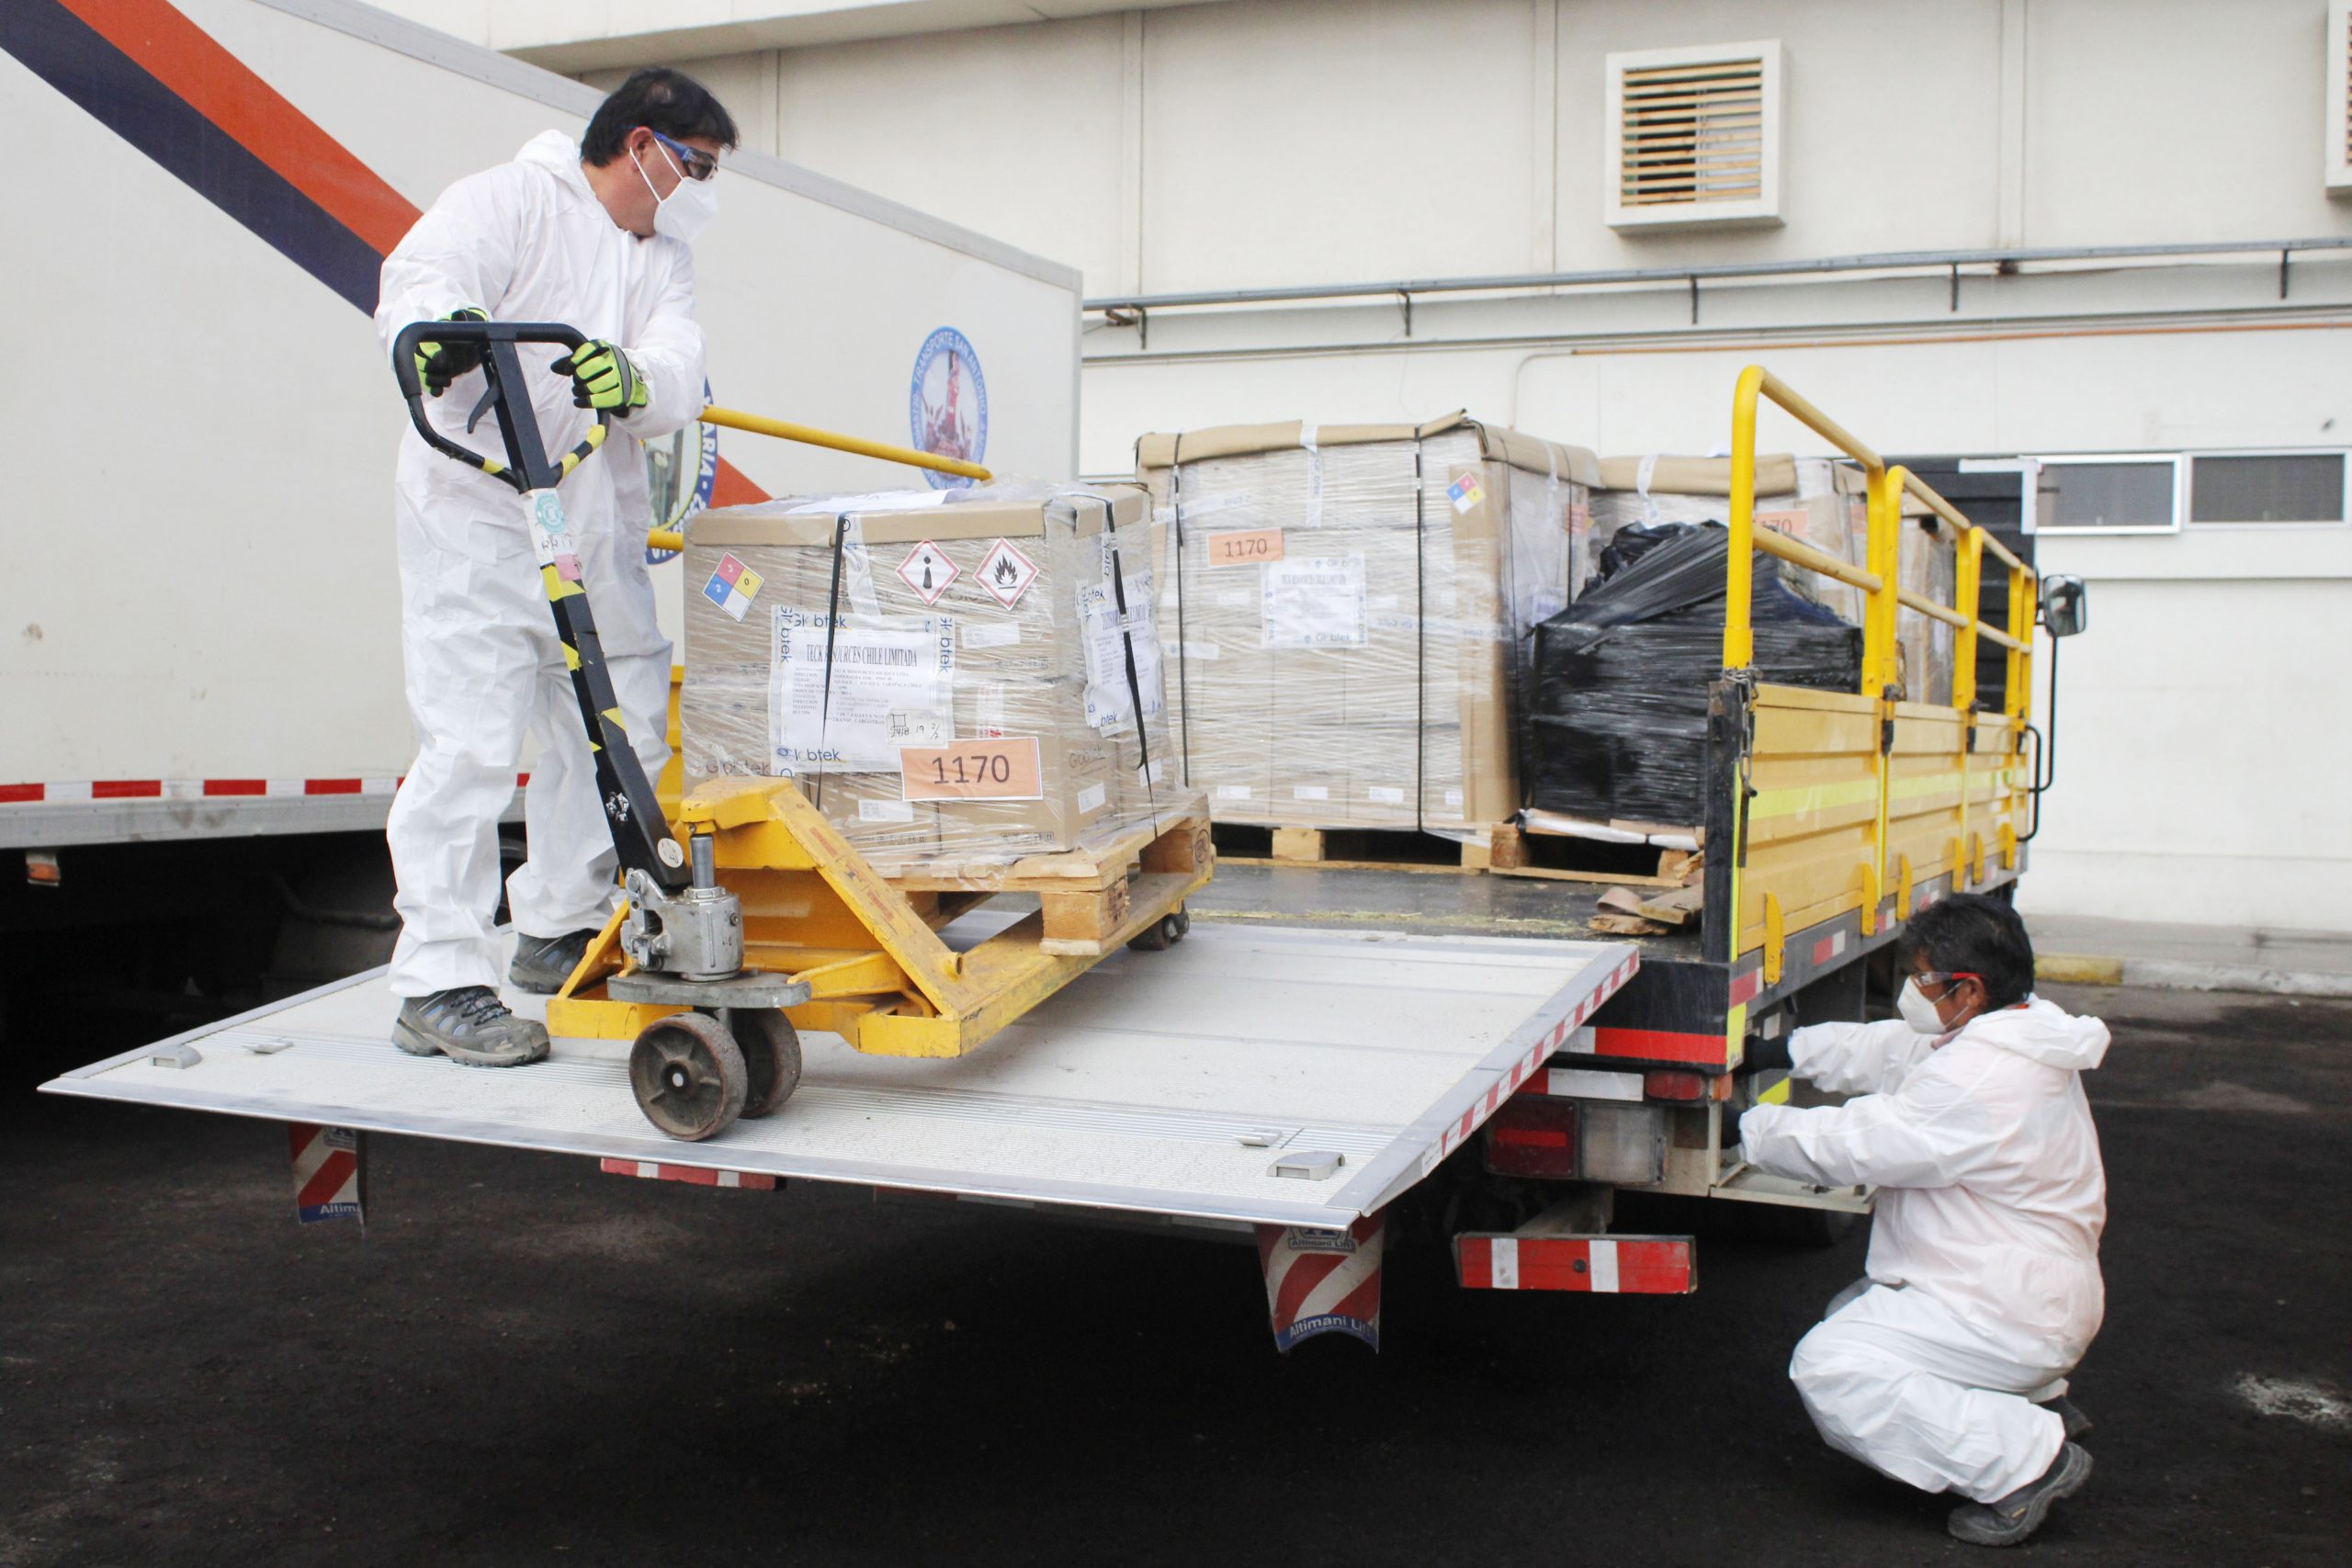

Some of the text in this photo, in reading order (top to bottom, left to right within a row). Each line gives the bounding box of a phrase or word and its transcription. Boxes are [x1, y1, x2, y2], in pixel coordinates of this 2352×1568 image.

[1224, 538, 1267, 558] 1170
[727, 564, 733, 573] 3
[715, 584, 721, 593] 2
[744, 578, 750, 586] 0
[793, 614, 847, 628] Glbtek
[940, 617, 953, 673] Glbtek
[807, 644, 918, 667] TECK RSOURCES CHILE LIMITADA
[932, 754, 1011, 784] 1170
[1289, 1316, 1347, 1338] Altimani
